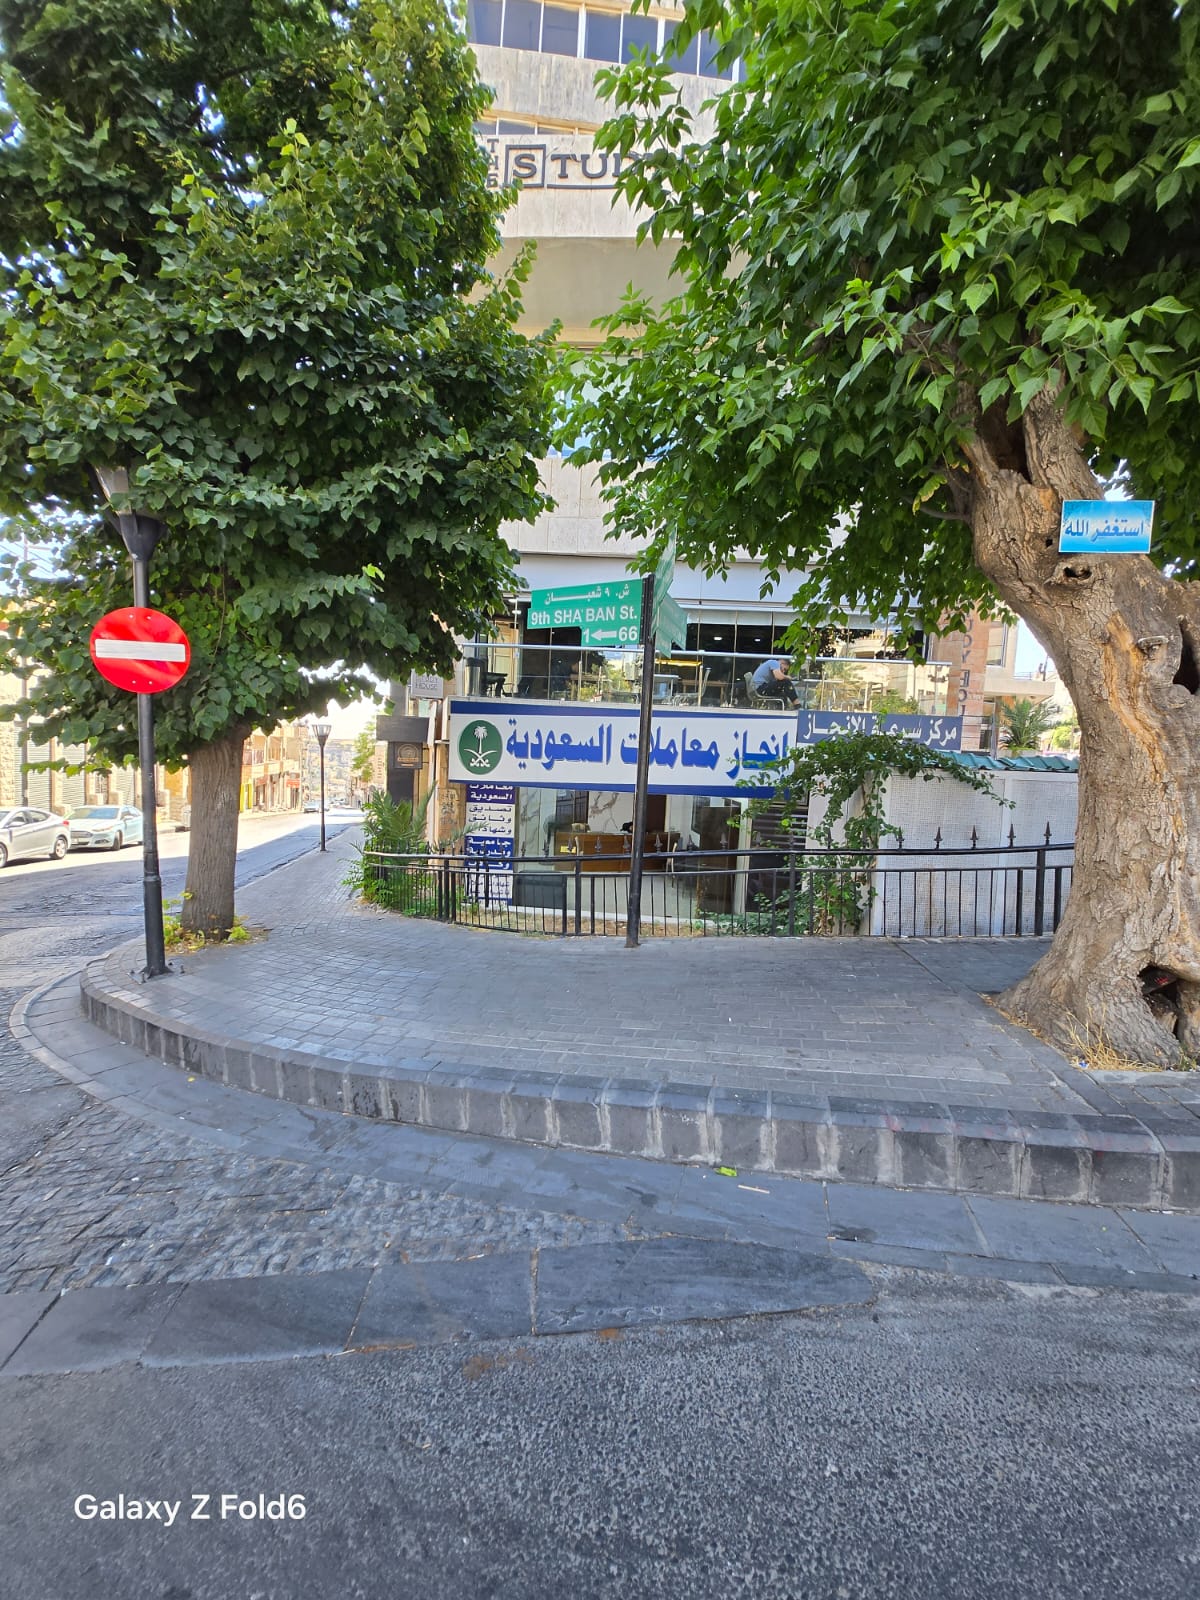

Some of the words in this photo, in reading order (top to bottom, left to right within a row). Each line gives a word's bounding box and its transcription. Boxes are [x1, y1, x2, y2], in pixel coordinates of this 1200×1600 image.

[486, 138, 499, 188] THE
[1064, 519, 1089, 537] الله
[1090, 519, 1144, 543] استغفر
[531, 611, 551, 626] 9th
[619, 604, 638, 620] St.
[583, 629, 590, 643] 1
[618, 626, 638, 642] 66
[506, 717, 613, 771] السعودية
[924, 718, 957, 747] مركز
[470, 791, 513, 801] السعودية
